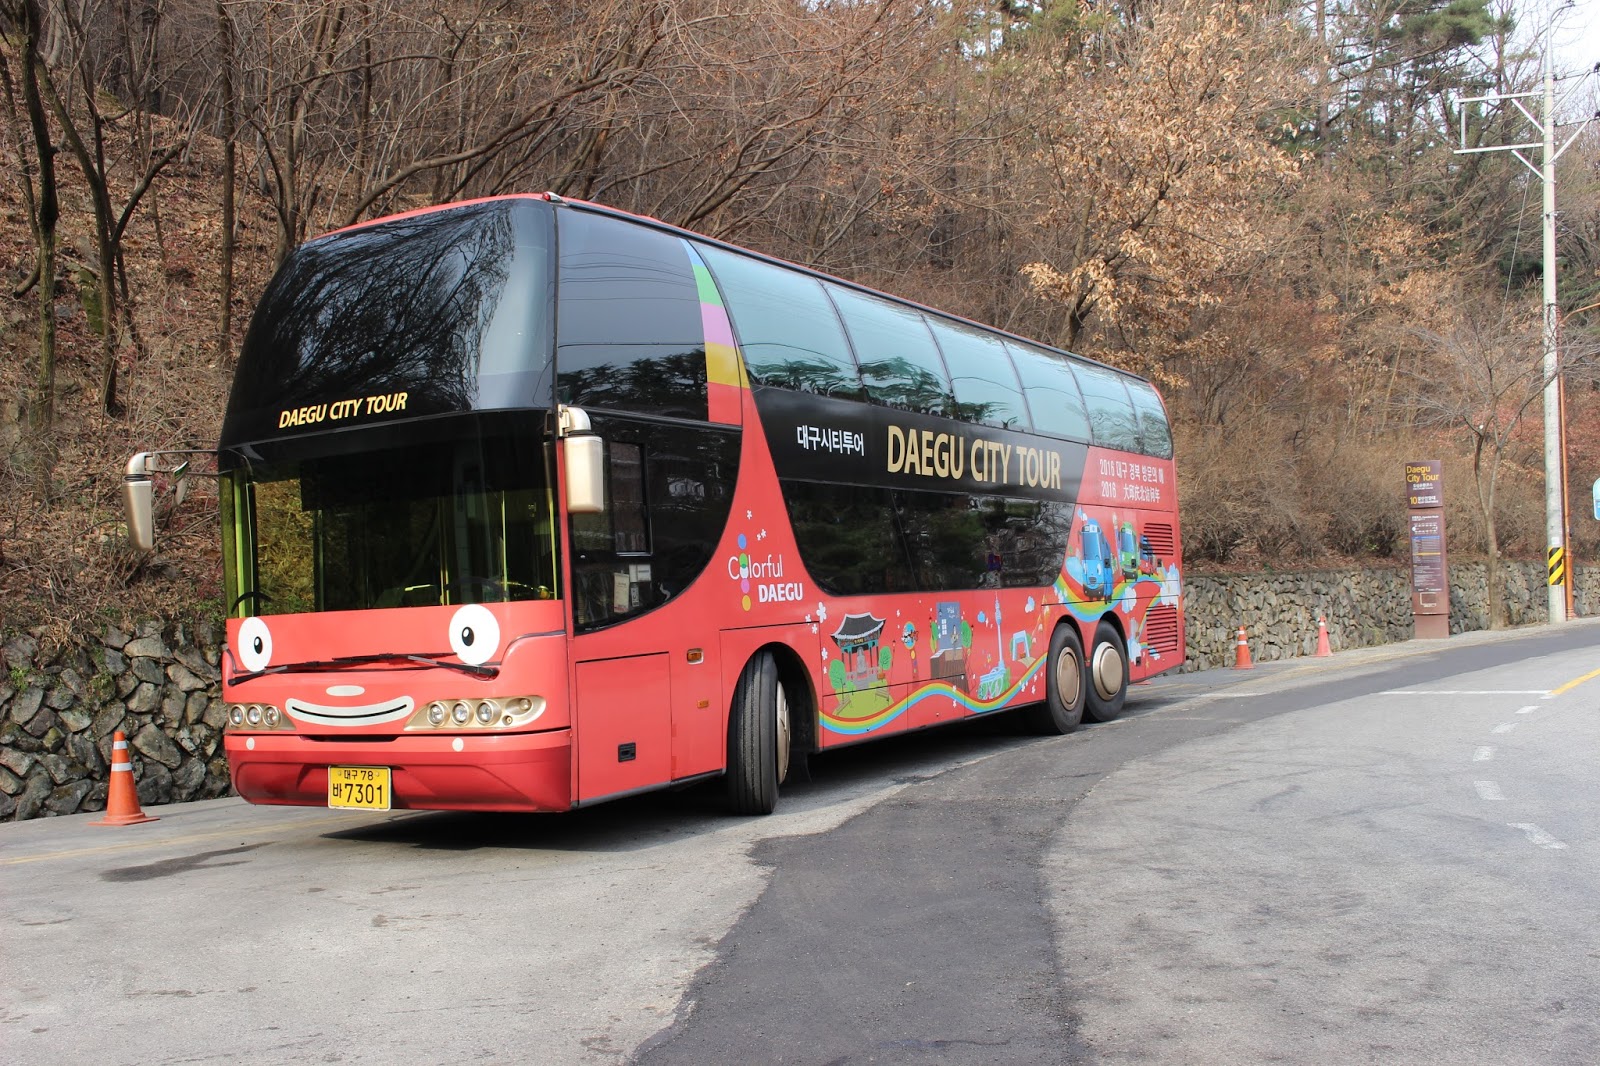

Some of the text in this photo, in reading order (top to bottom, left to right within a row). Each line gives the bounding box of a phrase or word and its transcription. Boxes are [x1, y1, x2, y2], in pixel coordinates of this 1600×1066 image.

[279, 392, 408, 429] DAEGU CITY TOUR
[796, 424, 865, 456] 대구시티투어
[886, 425, 1061, 490] DAEGU CITY TOUR
[1100, 459, 1115, 476] 2016
[1115, 461, 1128, 479] 대구
[1129, 463, 1141, 481] 경북
[1141, 465, 1157, 482] 방문의
[1406, 465, 1431, 474] Daegu
[1407, 473, 1440, 483] City Tour
[1101, 480, 1117, 498] 2016
[1409, 496, 1418, 505] 10
[728, 554, 783, 580] Colorful
[758, 582, 804, 603] DAEGU
[344, 770, 374, 781] 대구 78
